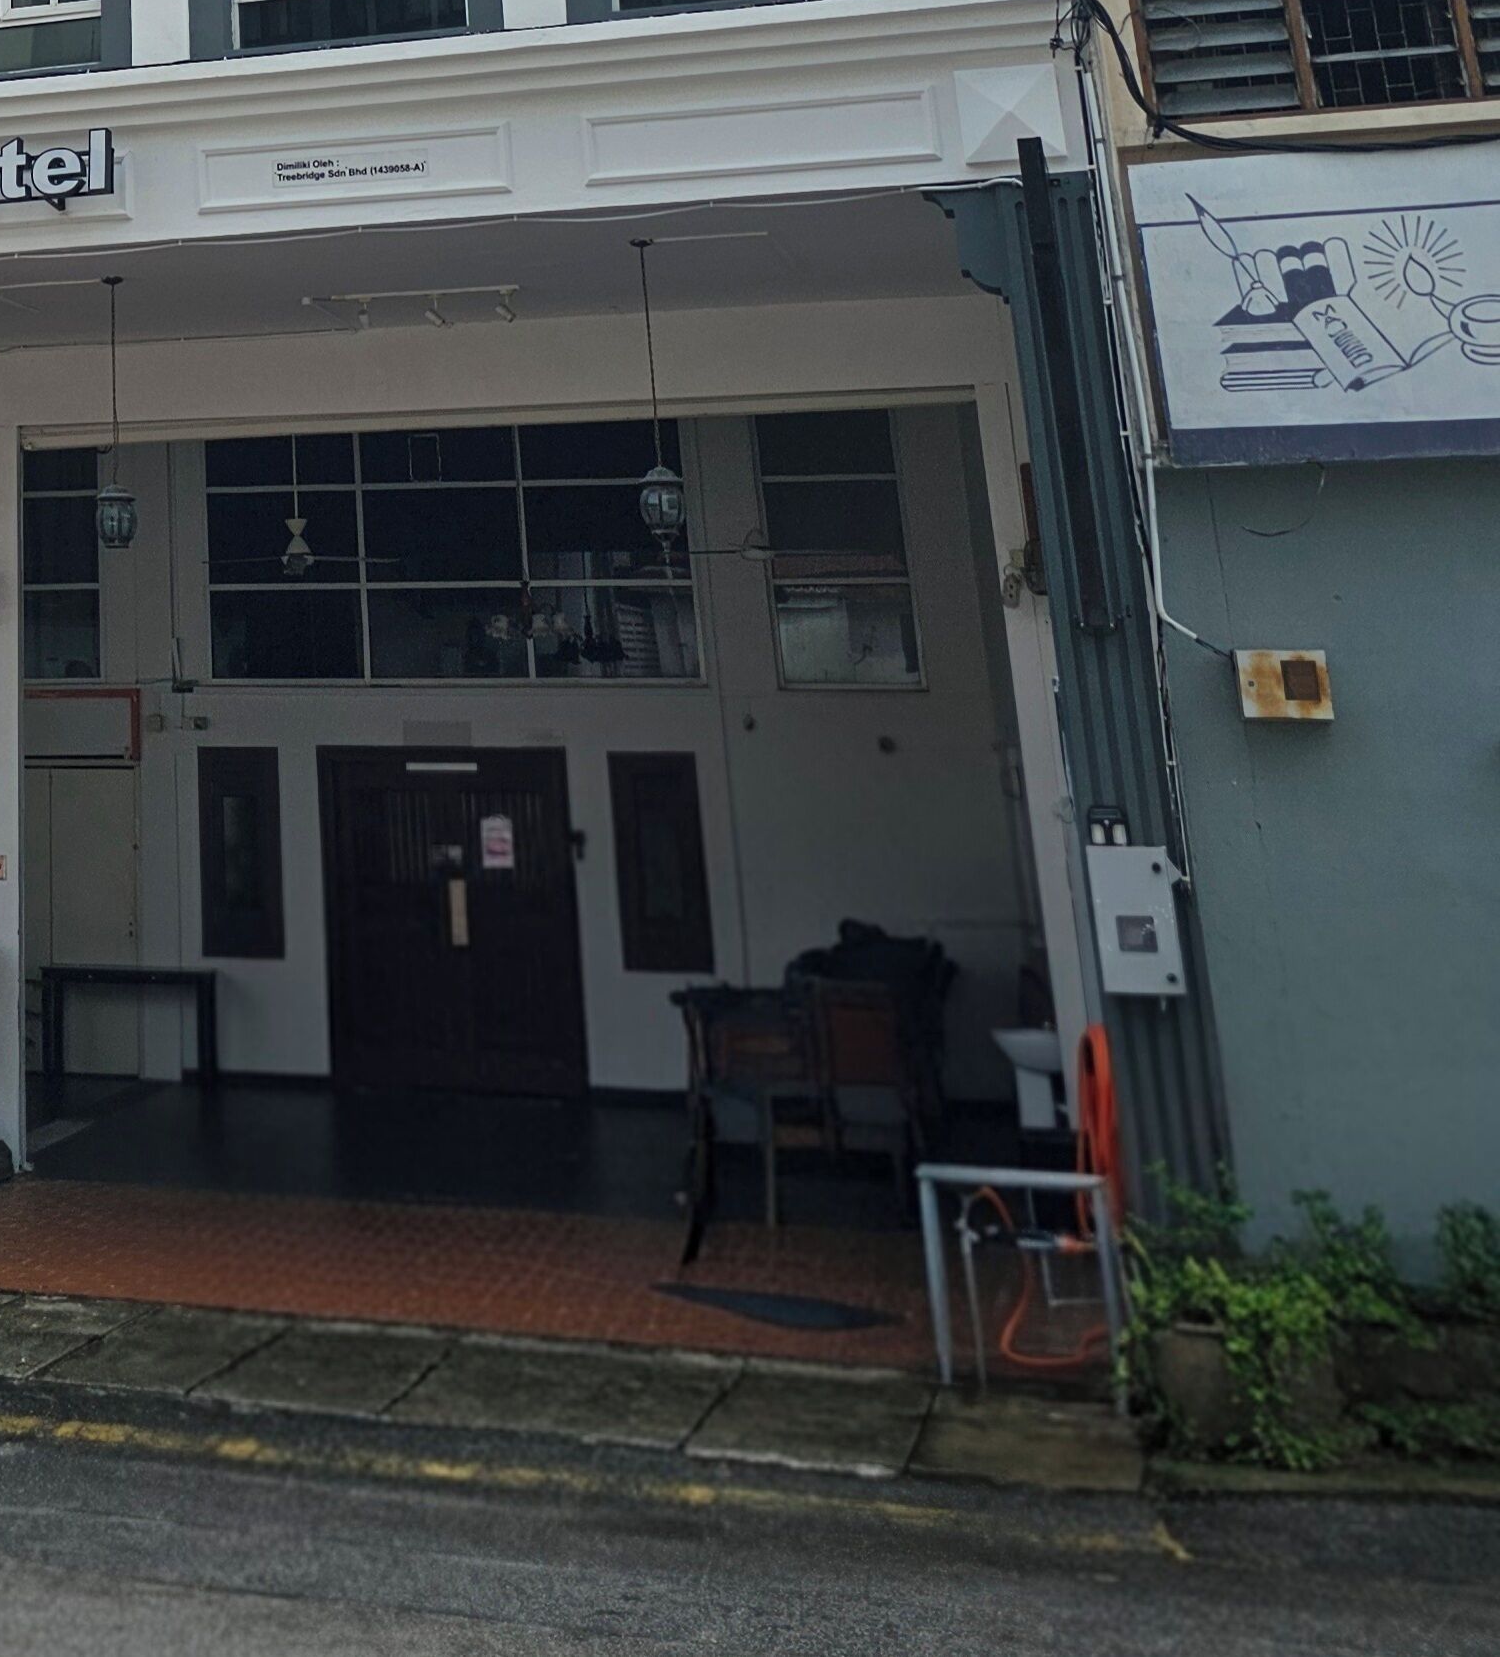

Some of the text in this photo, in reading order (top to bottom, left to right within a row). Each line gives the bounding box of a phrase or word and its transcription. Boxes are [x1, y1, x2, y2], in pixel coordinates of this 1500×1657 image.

[312, 159, 334, 168] Oleh
[276, 171, 325, 182] Treebridge
[328, 169, 346, 178] Sdn
[348, 166, 367, 176] Bhd
